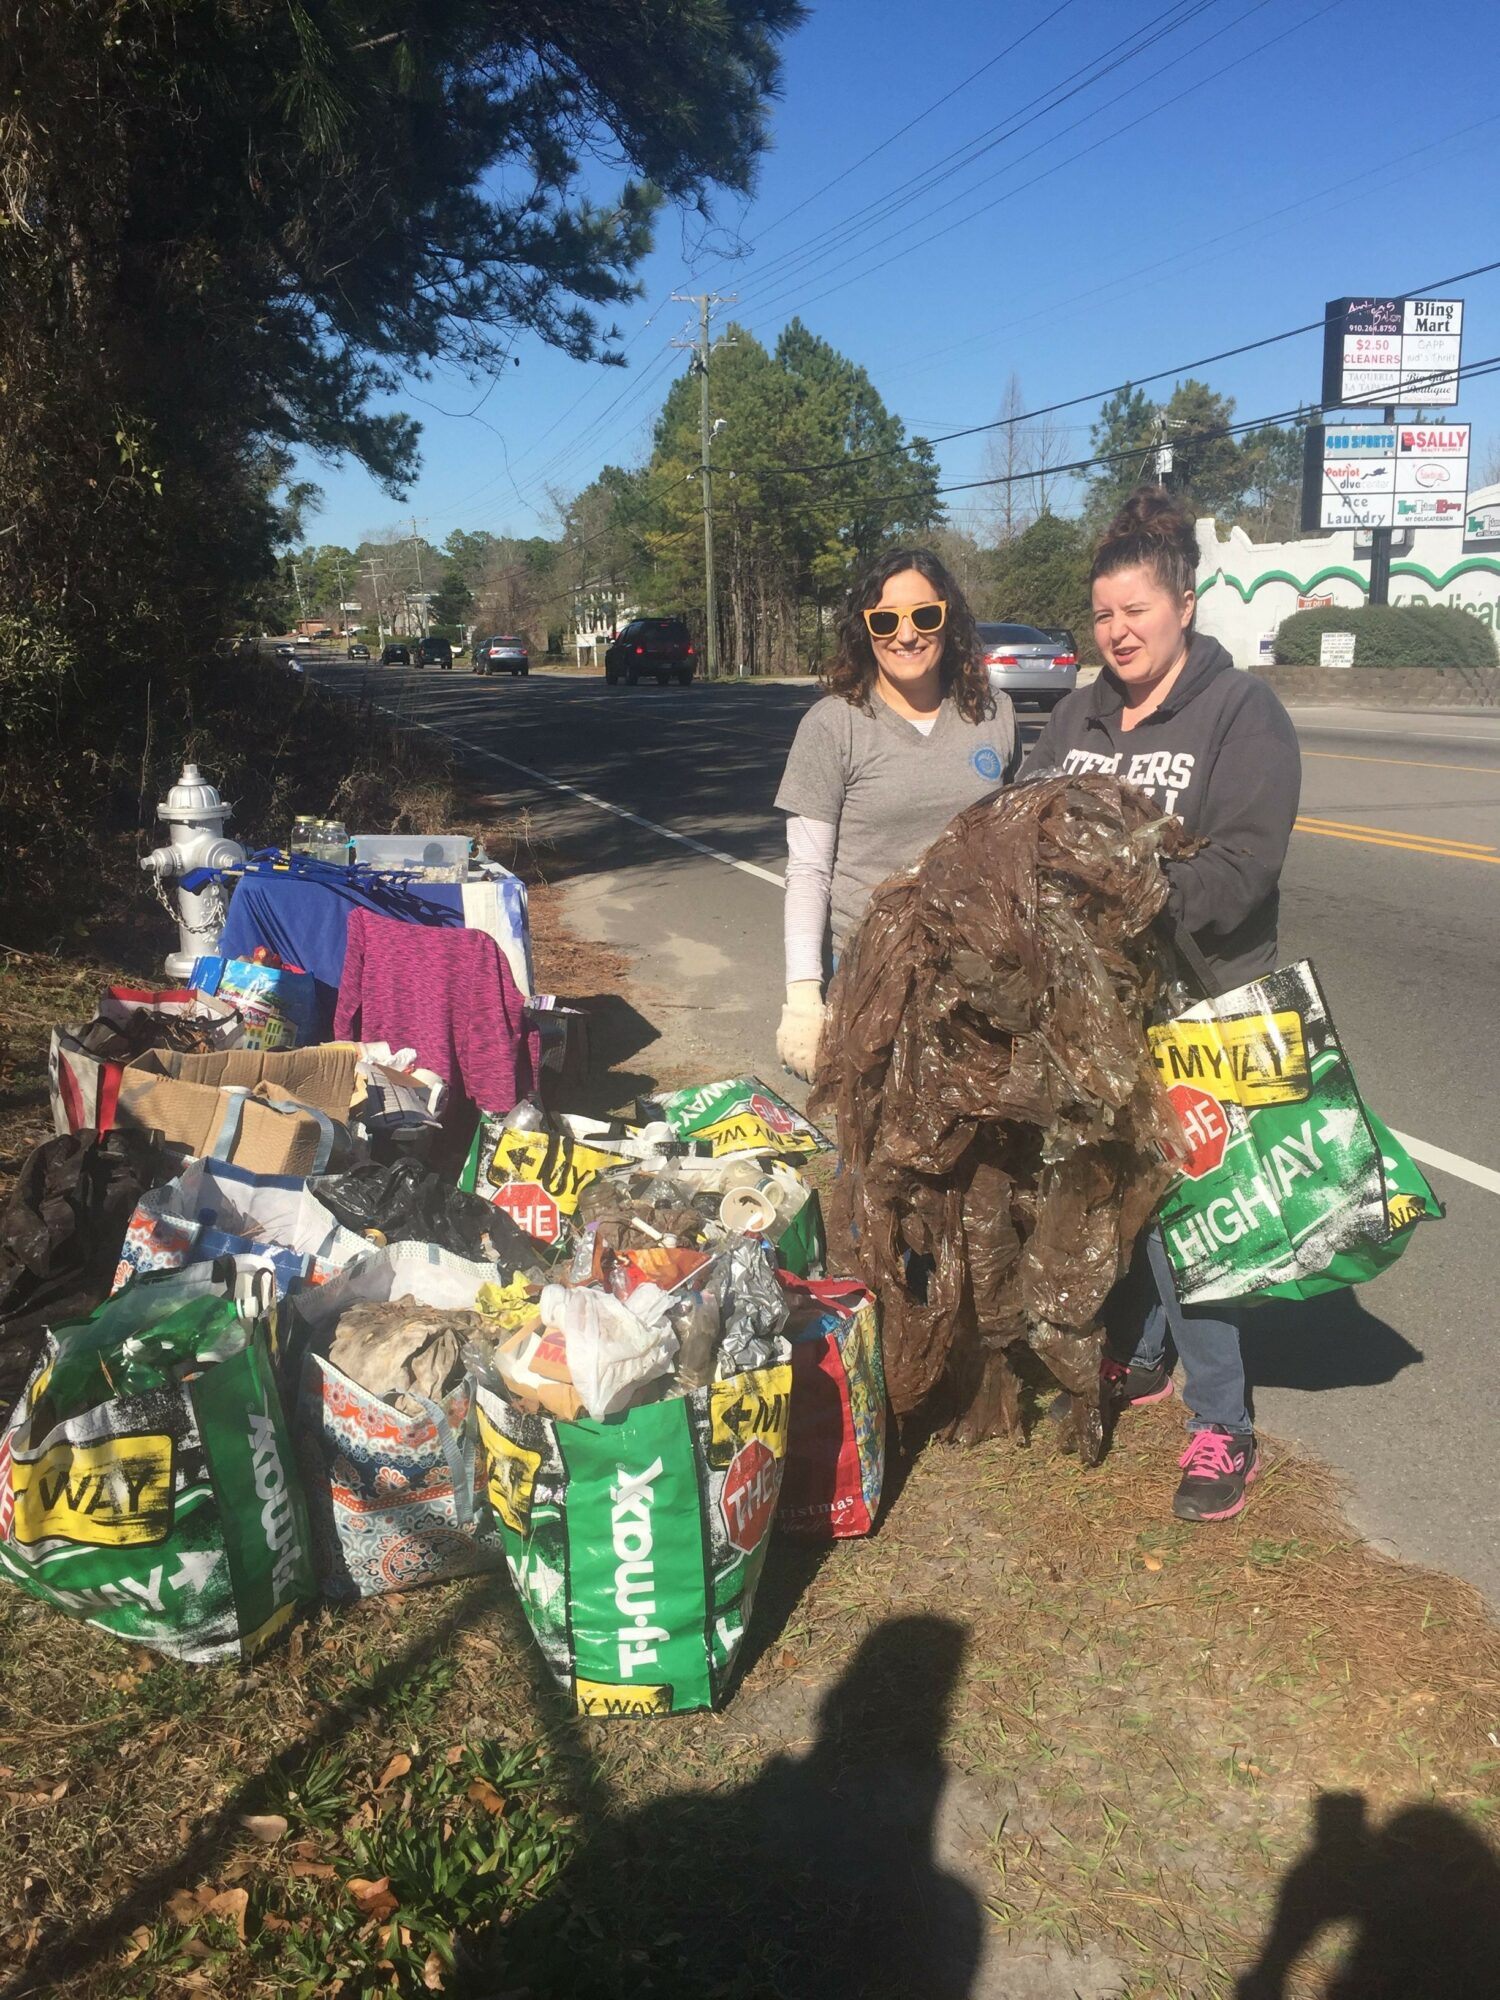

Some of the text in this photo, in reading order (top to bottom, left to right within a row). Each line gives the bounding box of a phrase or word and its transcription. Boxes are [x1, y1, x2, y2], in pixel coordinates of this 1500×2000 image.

[1414, 302, 1454, 320] Bling
[1415, 318, 1450, 332] Mart
[1356, 339, 1390, 351] $2.50
[1344, 354, 1401, 364] CLEANERS
[1351, 434, 1395, 448] SPORTS
[1416, 431, 1467, 448] SALLY
[1326, 466, 1360, 478] Patriot
[1342, 496, 1369, 507] Ace
[1327, 511, 1386, 527] Laundry
[753, 1103, 790, 1126] THE
[1184, 1099, 1224, 1152] HE
[38, 1468, 153, 1516] WAY
[726, 1456, 778, 1532] THE
[603, 1697, 664, 1716] WAY
